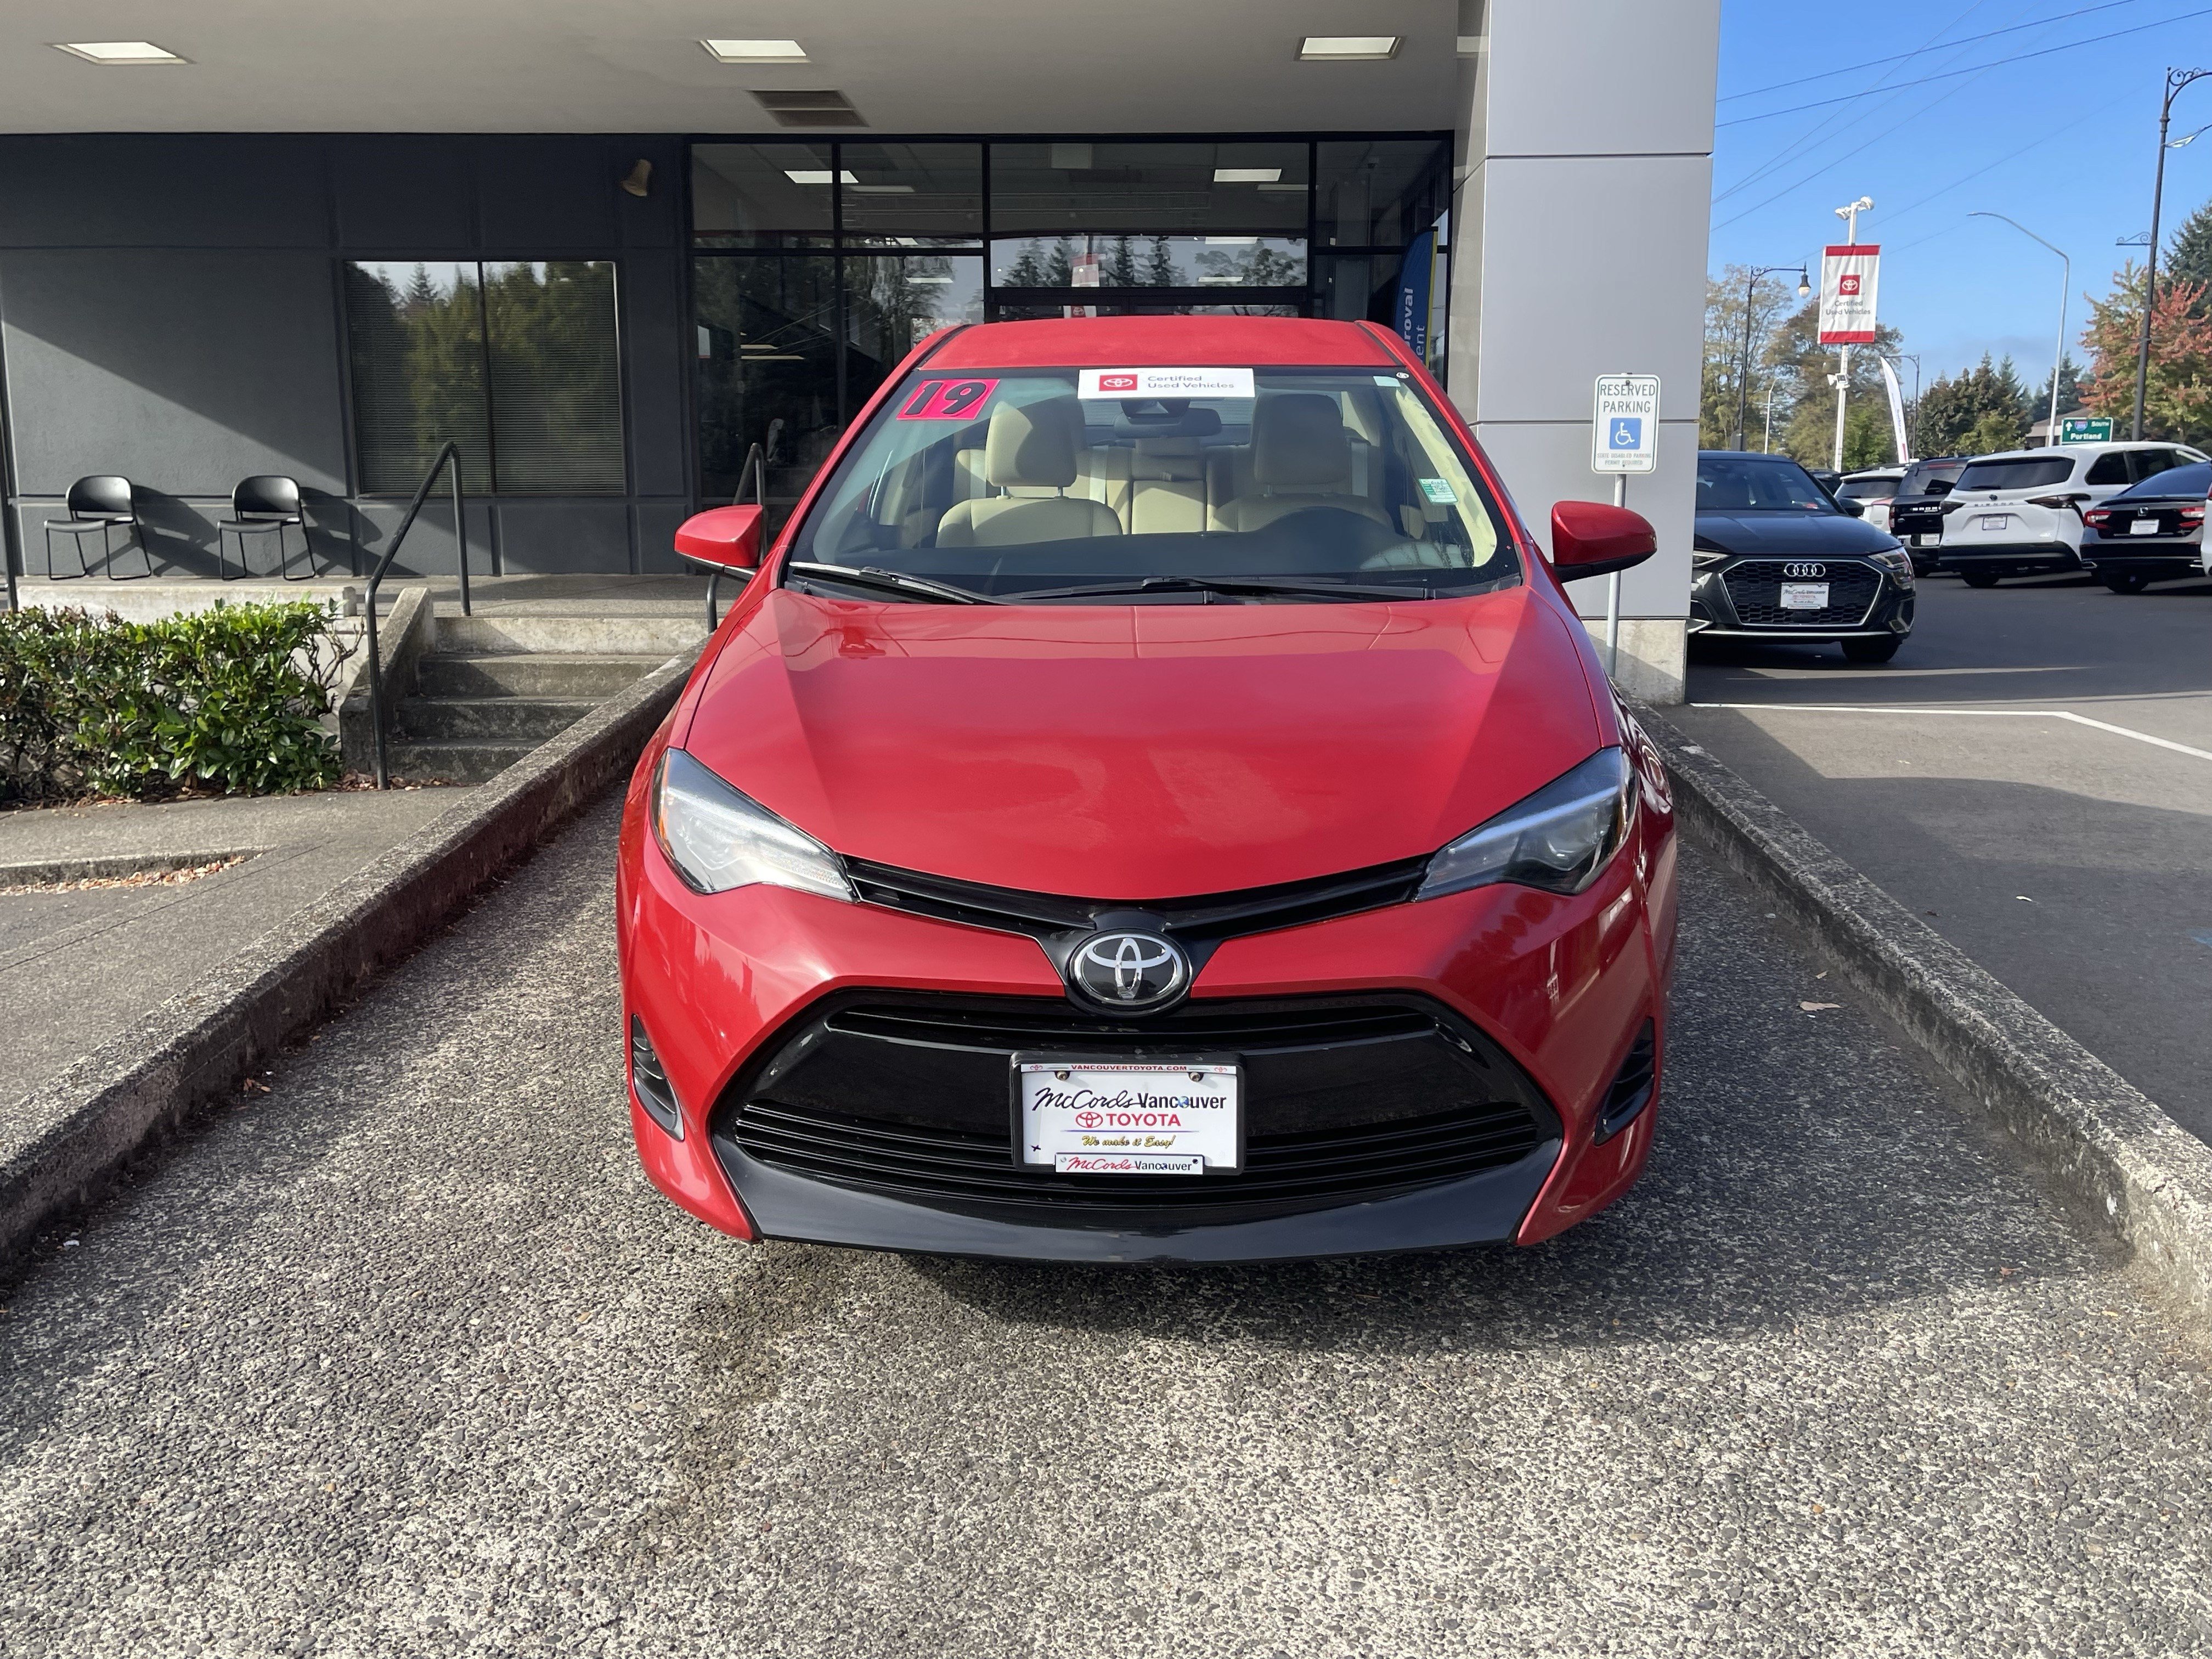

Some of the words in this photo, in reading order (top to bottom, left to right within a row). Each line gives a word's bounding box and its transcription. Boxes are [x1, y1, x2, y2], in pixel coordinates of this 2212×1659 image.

[1415, 324, 1425, 362] ent
[1600, 384, 1656, 396] RESERVED
[905, 381, 988, 416] 19
[1603, 401, 1651, 413] PARKING
[1105, 1113, 1182, 1126] TOYOTA
[1081, 1135, 1099, 1146] We
[1102, 1136, 1130, 1147] make
[1132, 1137, 1142, 1147] it
[1144, 1135, 1176, 1149] Easy!
